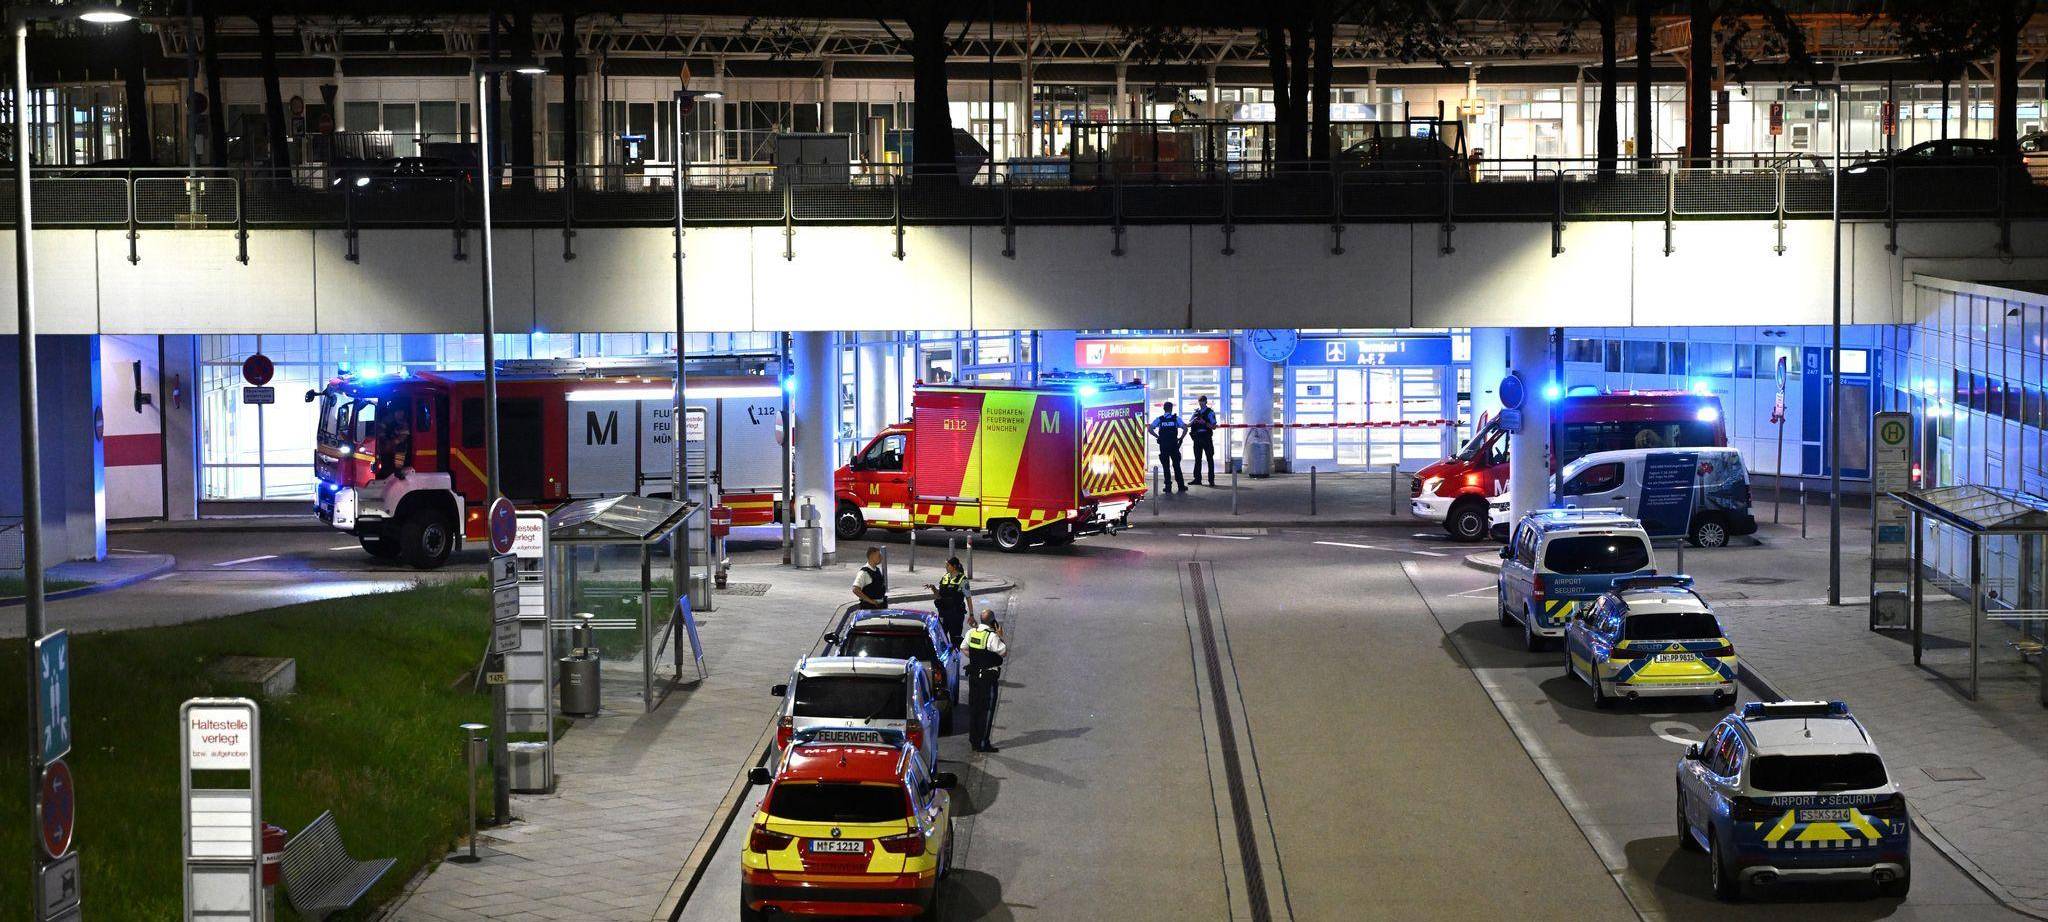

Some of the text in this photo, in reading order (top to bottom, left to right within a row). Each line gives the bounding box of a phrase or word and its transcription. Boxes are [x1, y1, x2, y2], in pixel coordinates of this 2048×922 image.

[1152, 343, 1181, 356] Airport
[1182, 343, 1209, 354] Center
[1358, 341, 1406, 353] Terminal 1
[757, 406, 775, 416] 112
[1097, 408, 1130, 419] FEUERWEHR
[949, 419, 968, 431] 112
[986, 416, 1025, 424] FEUERWEHR
[1041, 410, 1060, 433] M
[586, 410, 618, 445] M
[986, 423, 1018, 432] MÜNCHEN
[1901, 448, 1907, 461] 1
[869, 483, 880, 495] M
[191, 719, 248, 730] Haltestelle
[201, 734, 239, 745] verlegt
[818, 731, 879, 742] FEUERWEHR
[211, 749, 248, 758] aufgehoben
[1771, 795, 1877, 805] AIRPORT SECURITY
[1800, 810, 1815, 819] FS
[1892, 823, 1905, 835] 17
[816, 842, 860, 851] M F 1212
